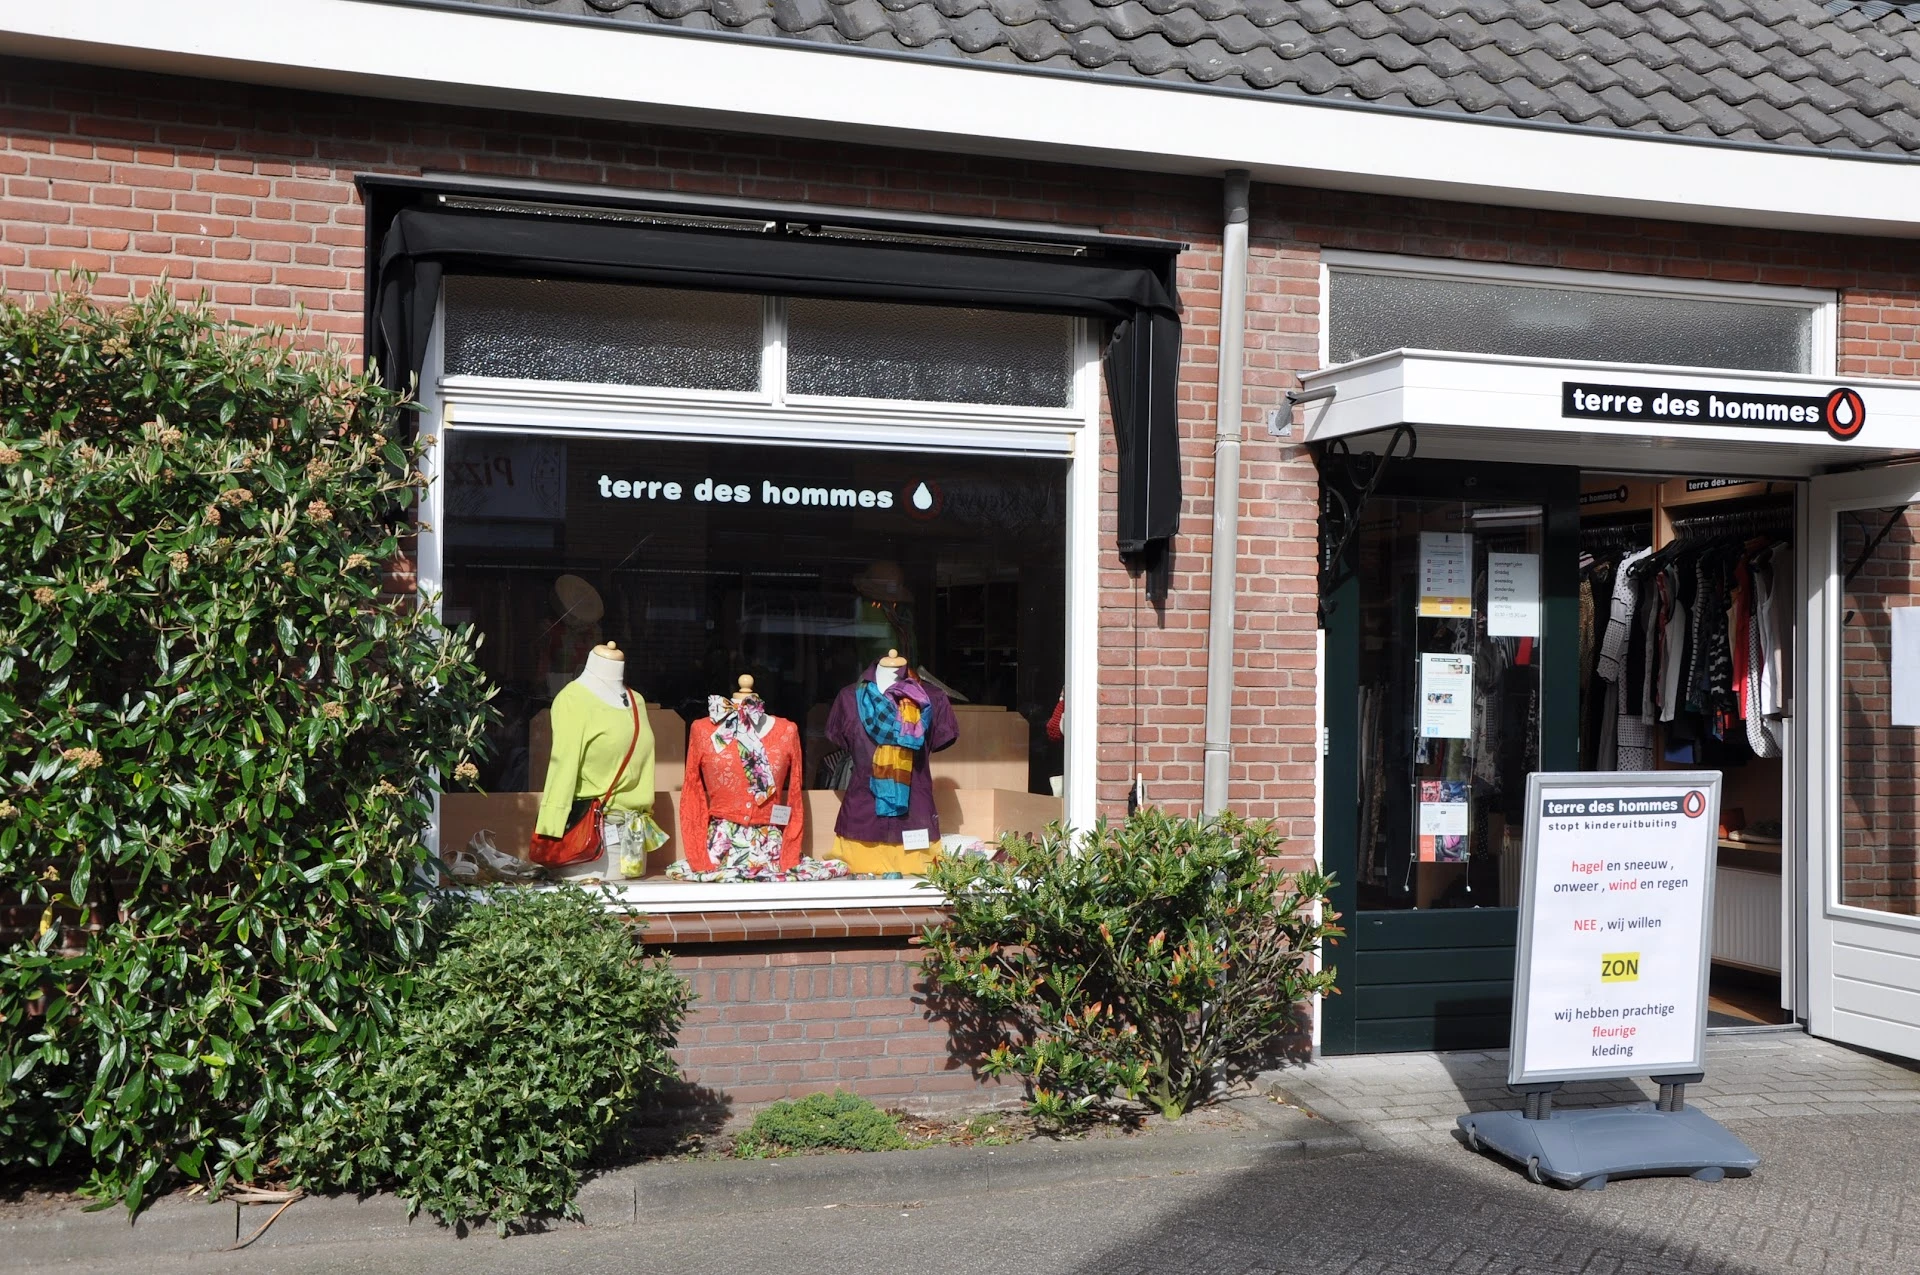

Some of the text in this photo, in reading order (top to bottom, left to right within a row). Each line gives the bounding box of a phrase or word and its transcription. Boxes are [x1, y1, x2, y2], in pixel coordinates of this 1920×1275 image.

[1573, 388, 1819, 422] terre des hommes
[598, 474, 893, 508] terre des hommes
[1688, 480, 1709, 489] terre
[1547, 799, 1678, 814] terre des hommes
[1548, 819, 1677, 831] stopt kinderuitbuiting
[1571, 859, 1604, 874] hagel
[1606, 862, 1621, 872] en
[1624, 860, 1668, 871] sneeuw
[1553, 881, 1599, 893] onweer
[1608, 878, 1637, 890] wind
[1640, 880, 1654, 889] en
[1656, 878, 1689, 891] regen
[1573, 919, 1597, 931] NEE
[1607, 919, 1625, 931] wij
[1627, 917, 1662, 929] willen
[1601, 959, 1639, 977] ZON
[1554, 1002, 1675, 1022] wij hebben prachtige
[1592, 1025, 1637, 1038] fleurige
[1591, 1044, 1634, 1057] kleding
